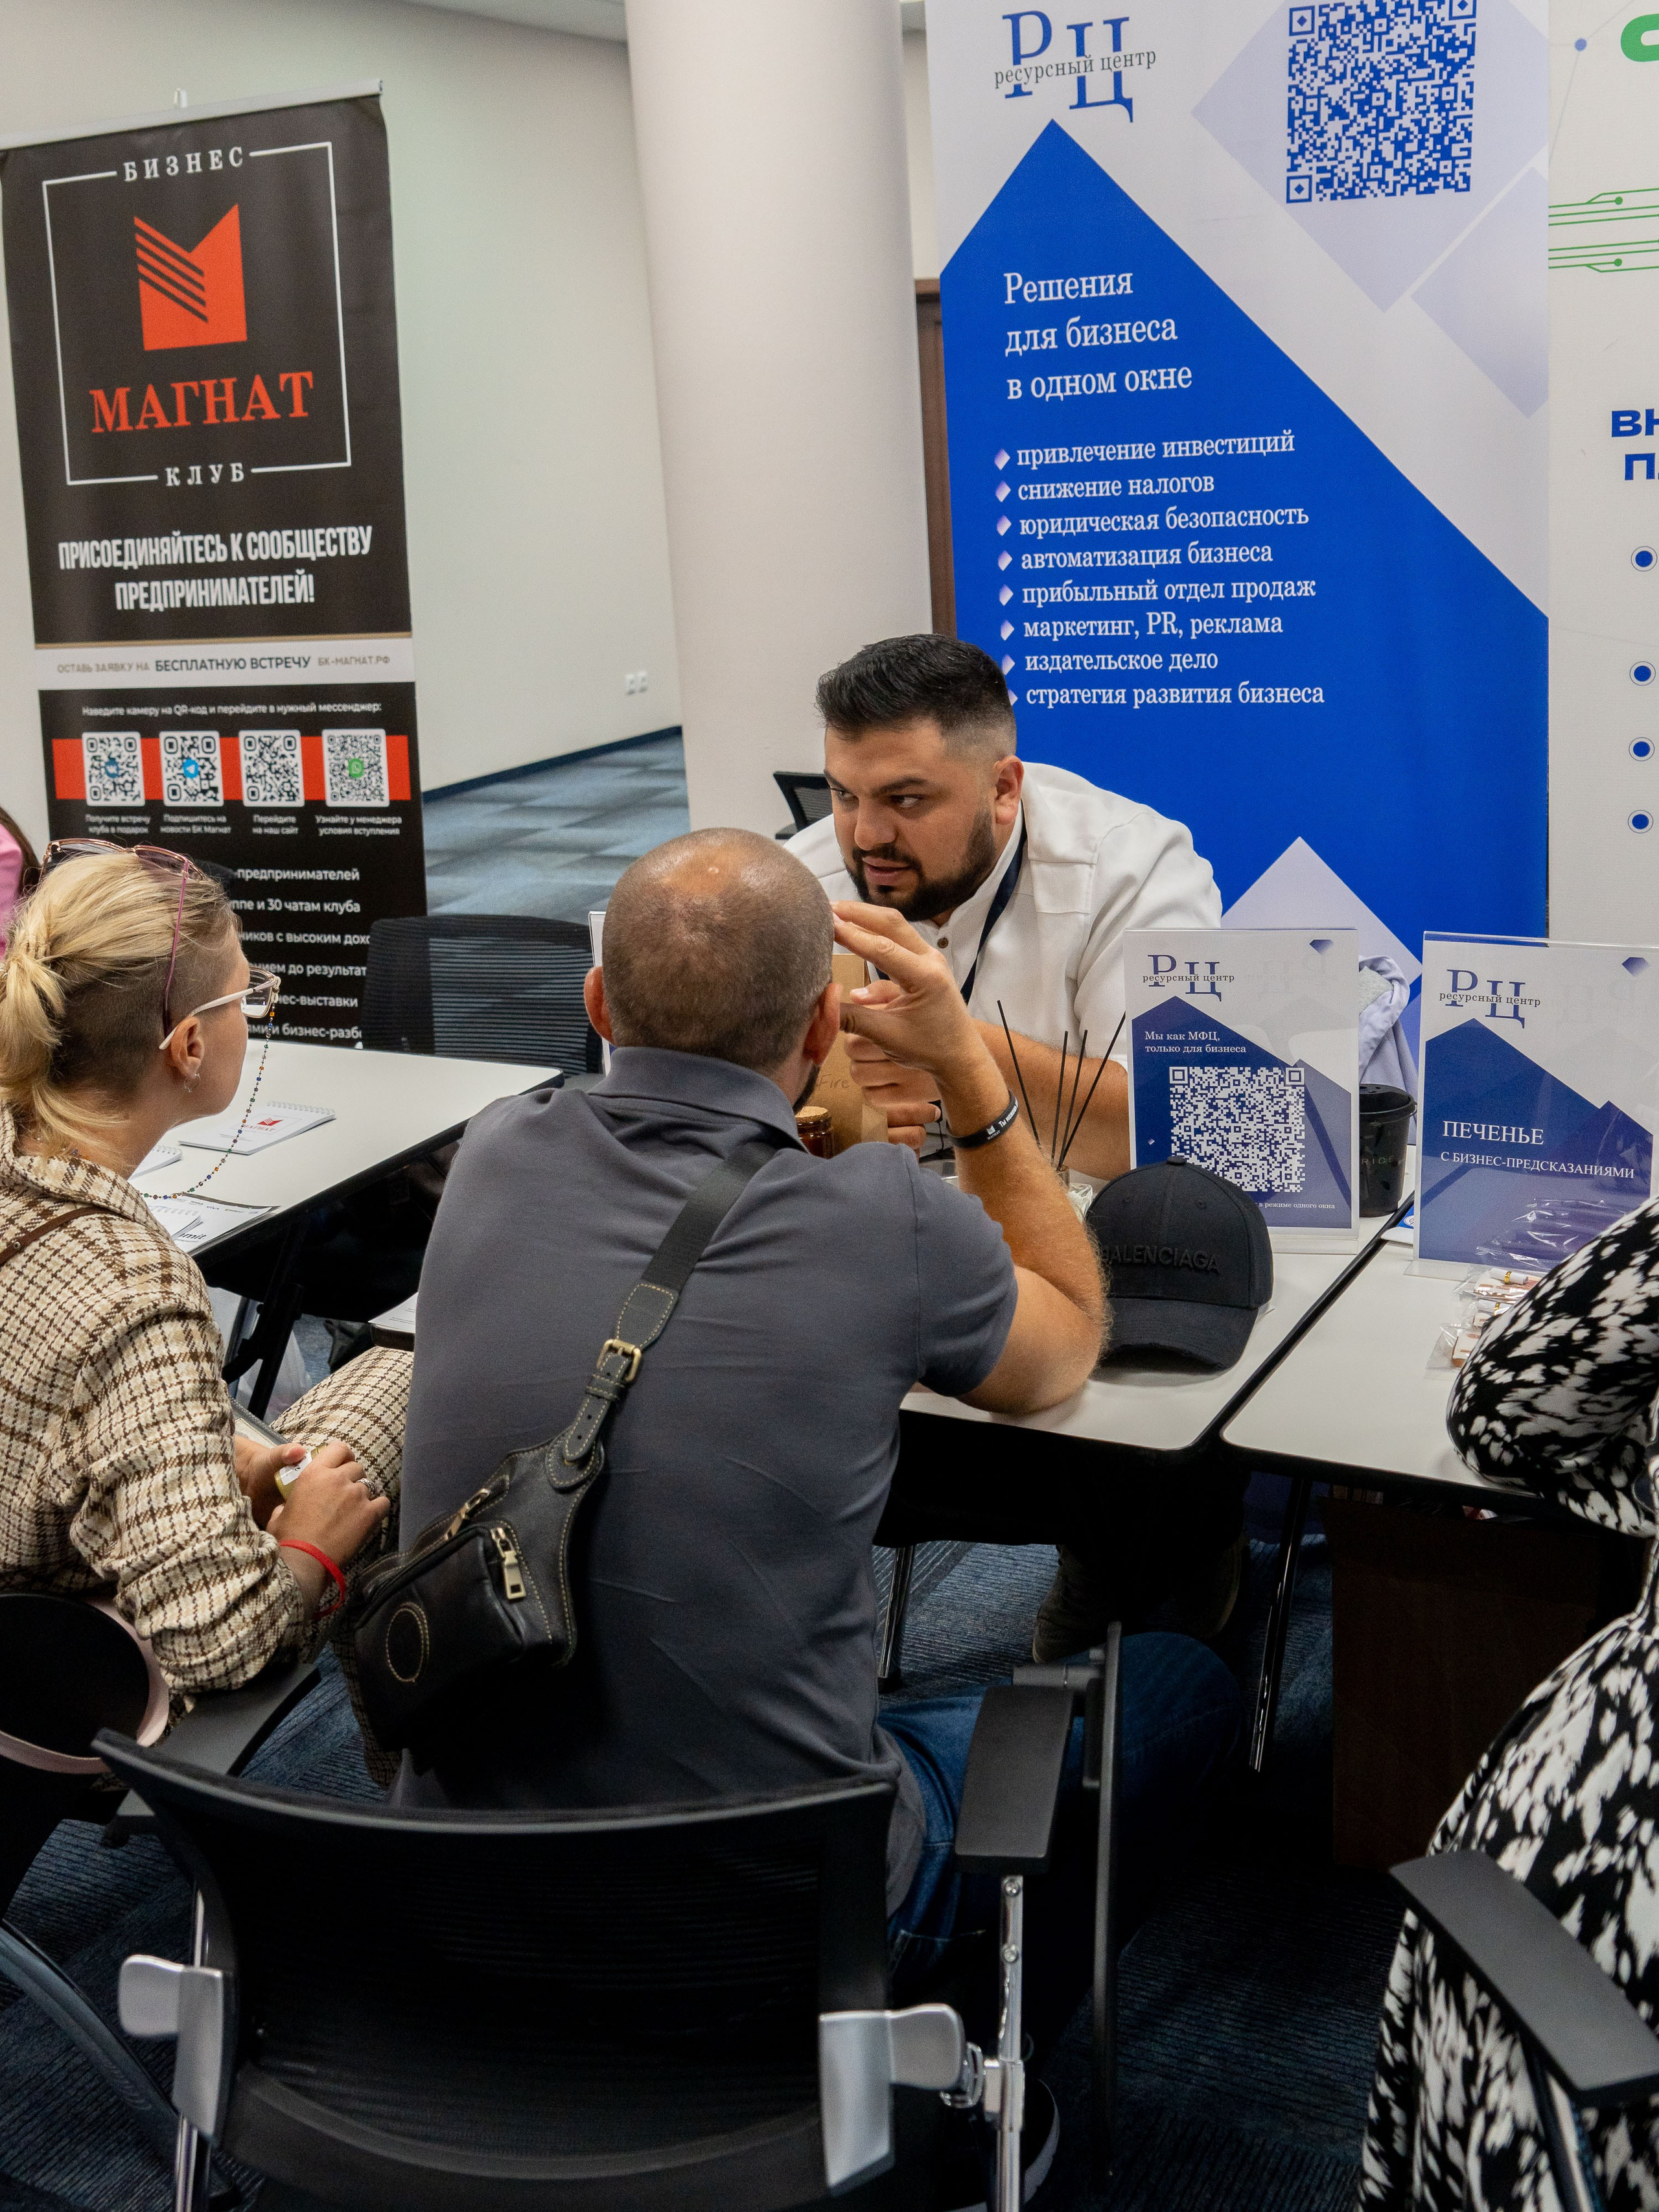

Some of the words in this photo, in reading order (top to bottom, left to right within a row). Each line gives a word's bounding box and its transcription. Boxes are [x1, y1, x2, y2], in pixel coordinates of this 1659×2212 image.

[994, 54, 1094, 89] ресурсный
[1100, 48, 1157, 73] центр
[122, 146, 244, 181] БИЗНЕС
[1003, 272, 1133, 305] Решения
[1005, 328, 1058, 357] для
[1066, 316, 1178, 348] бизнеса
[1007, 378, 1022, 399] в
[1030, 370, 1117, 402] одном
[1124, 366, 1192, 391] окне
[89, 371, 314, 433] МАГНАТ
[1017, 441, 1156, 469] привлечение
[1162, 429, 1295, 458] инвестиций
[165, 462, 245, 487] КЛУБ
[1017, 479, 1122, 500] снижение
[1128, 474, 1215, 496] налогов
[1019, 513, 1159, 539] юридическая
[1165, 506, 1310, 530] безопасность
[58, 530, 227, 570] ПРИСОЕДИНЯЙТЕСЬ
[231, 533, 245, 561] К
[246, 526, 373, 560] СООБЩЕСТВУ
[1021, 548, 1182, 570] автоматизация
[1187, 541, 1273, 564] бизнеса
[115, 569, 315, 612] ПРЕДПРИНИМАТЕЛЕЙ!
[1022, 579, 1158, 608] прибыльный
[1164, 581, 1225, 603] отдел
[1231, 578, 1316, 603] продаж
[1023, 618, 1140, 640] маркетинг,
[1146, 612, 1183, 639] PR,
[1190, 614, 1283, 639] реклама
[57, 663, 93, 673] ОСТАВЬ
[95, 663, 133, 672] ЗАЯВКУ
[136, 662, 150, 671] НА
[156, 658, 246, 671] БЕСПЛАТНУЮ
[251, 657, 311, 669] ВСТРЕЧУ
[318, 655, 390, 666] БК-МАГНАТ.РФ
[1025, 652, 1163, 673] издательское
[1168, 651, 1218, 673] дело
[1026, 686, 1127, 708] стратегия
[1133, 686, 1232, 709] развития
[1238, 681, 1325, 704] бизнеса
[82, 706, 124, 716] Наведите
[126, 706, 159, 717] камеру
[173, 704, 208, 716] QR-код
[217, 703, 267, 716] перейдите
[277, 703, 316, 715] нужный
[318, 703, 382, 714] мессенджер:
[318, 826, 353, 836] условия
[353, 827, 400, 836] вступления
[257, 901, 265, 911] и
[267, 898, 283, 911] 30
[284, 901, 321, 912] чатам
[323, 900, 361, 915] клуба
[276, 933, 283, 942] с
[285, 933, 342, 944] высоким
[288, 964, 304, 975] до
[307, 965, 367, 978] результат
[1143, 974, 1200, 983] ресурсный
[1439, 992, 1502, 1003] ресурсный
[1506, 996, 1540, 1007] центр
[272, 1025, 279, 1035] и
[1145, 1031, 1163, 1040] Мы
[1188, 1031, 1220, 1042] МФЦ,
[1205, 1044, 1246, 1053] бизнеса
[1443, 1121, 1544, 1145] ПЕЧЕНЬЕ
[1441, 1151, 1450, 1161] С
[1453, 1152, 1634, 1178] БИЗНЕС-ПРЕДСКАЗАНИЯМИ
